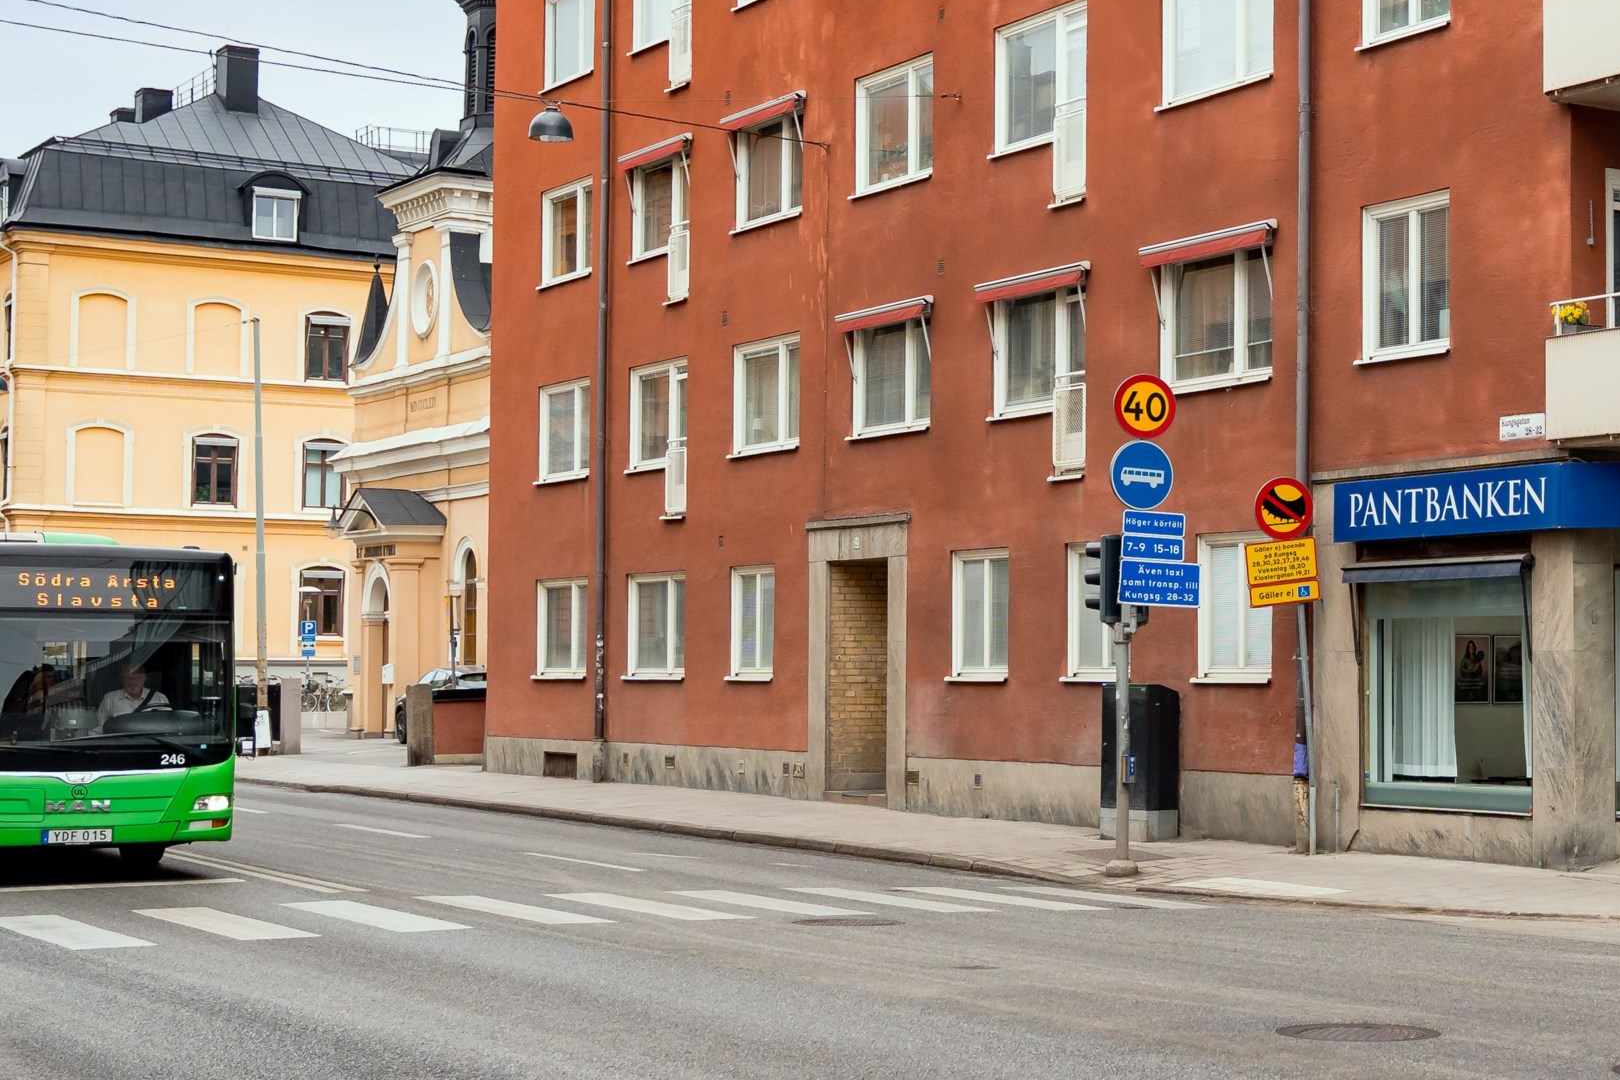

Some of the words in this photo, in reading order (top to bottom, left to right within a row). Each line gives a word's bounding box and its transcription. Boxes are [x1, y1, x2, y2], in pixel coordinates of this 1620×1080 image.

[1124, 391, 1166, 422] 40
[1349, 477, 1547, 527] PANTBANKEN
[1126, 517, 1151, 527] Höger
[1154, 520, 1182, 528] körfält
[1126, 542, 1146, 552] 7-9
[1154, 544, 1180, 554] 15-18
[1282, 542, 1305, 550] boende
[1138, 564, 1162, 575] Även
[1165, 568, 1184, 576] taxi
[1289, 563, 1306, 571] 18,20
[18, 572, 91, 587] Södra
[1254, 572, 1294, 581] Klostergatan
[1149, 580, 1182, 590] transp.
[1185, 582, 1198, 590] till
[37, 592, 158, 608] Slavsta
[1125, 591, 1163, 601] Kungsg.
[1167, 593, 1194, 602] 28-32
[1259, 591, 1283, 600] Gäller
[1286, 589, 1294, 598] ej
[305, 623, 314, 634] P
[161, 754, 186, 765] 246
[45, 799, 111, 813] MAN
[54, 831, 78, 842] YDF
[82, 830, 107, 841] 015
